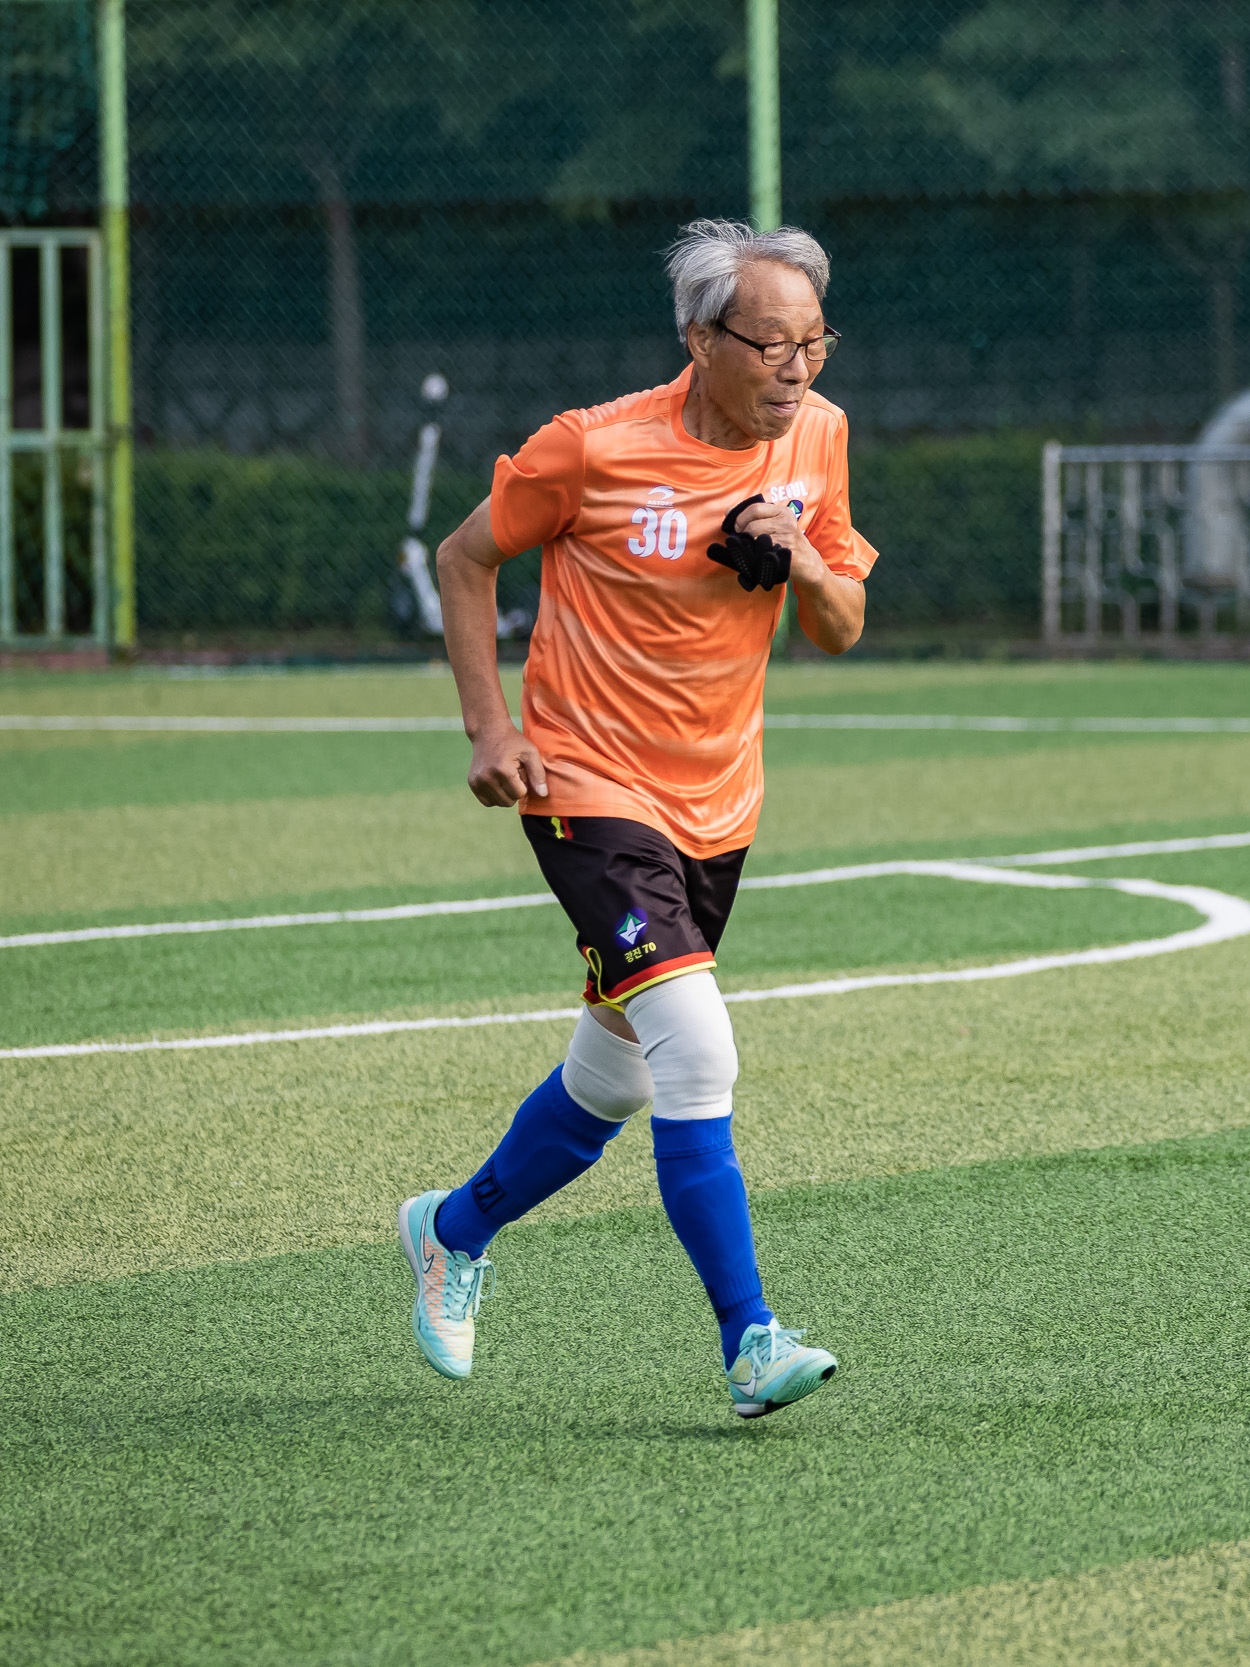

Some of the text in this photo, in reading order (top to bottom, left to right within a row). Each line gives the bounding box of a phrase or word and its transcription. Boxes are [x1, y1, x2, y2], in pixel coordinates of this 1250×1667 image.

[770, 481, 808, 502] SEOUL
[628, 508, 688, 560] 30
[641, 942, 657, 954] 70
